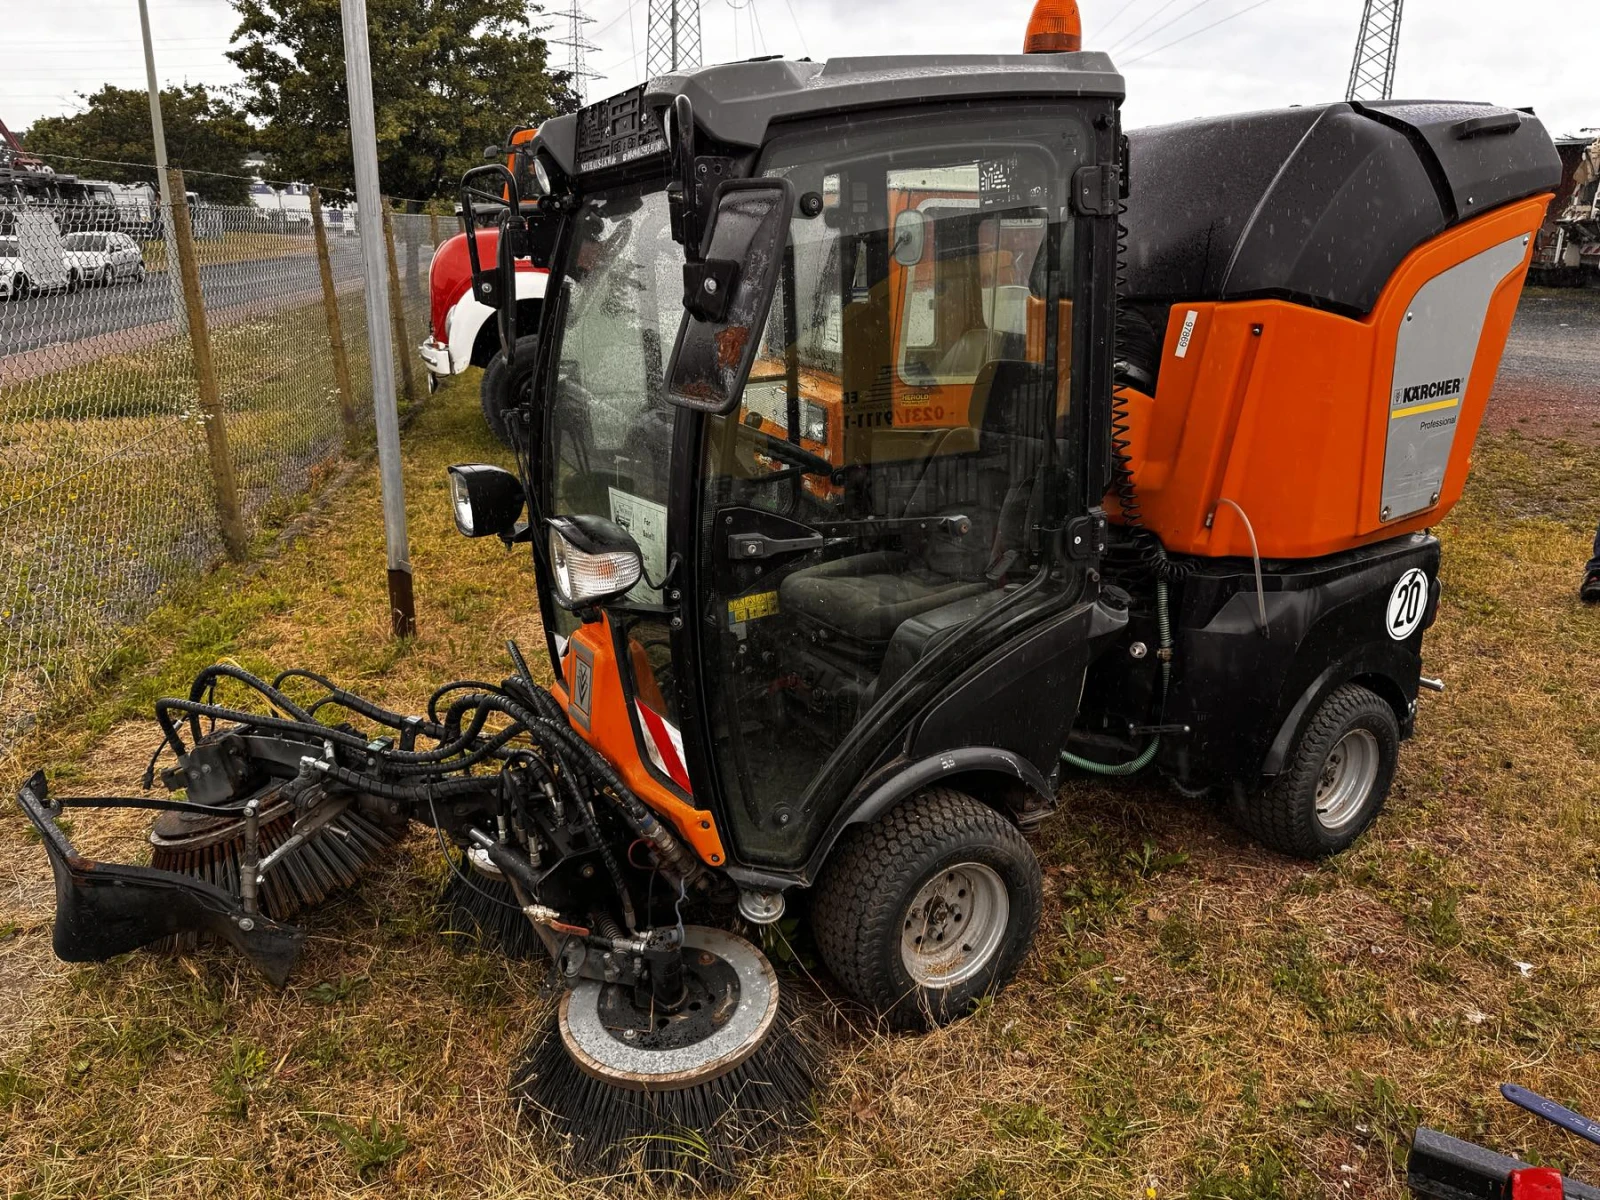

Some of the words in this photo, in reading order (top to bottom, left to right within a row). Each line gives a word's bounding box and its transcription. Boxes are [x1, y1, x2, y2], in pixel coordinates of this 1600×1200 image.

[1179, 321, 1193, 347] 97869
[1403, 378, 1461, 403] KÄRCHER
[1420, 415, 1457, 431] Professional
[1393, 580, 1421, 629] 20
